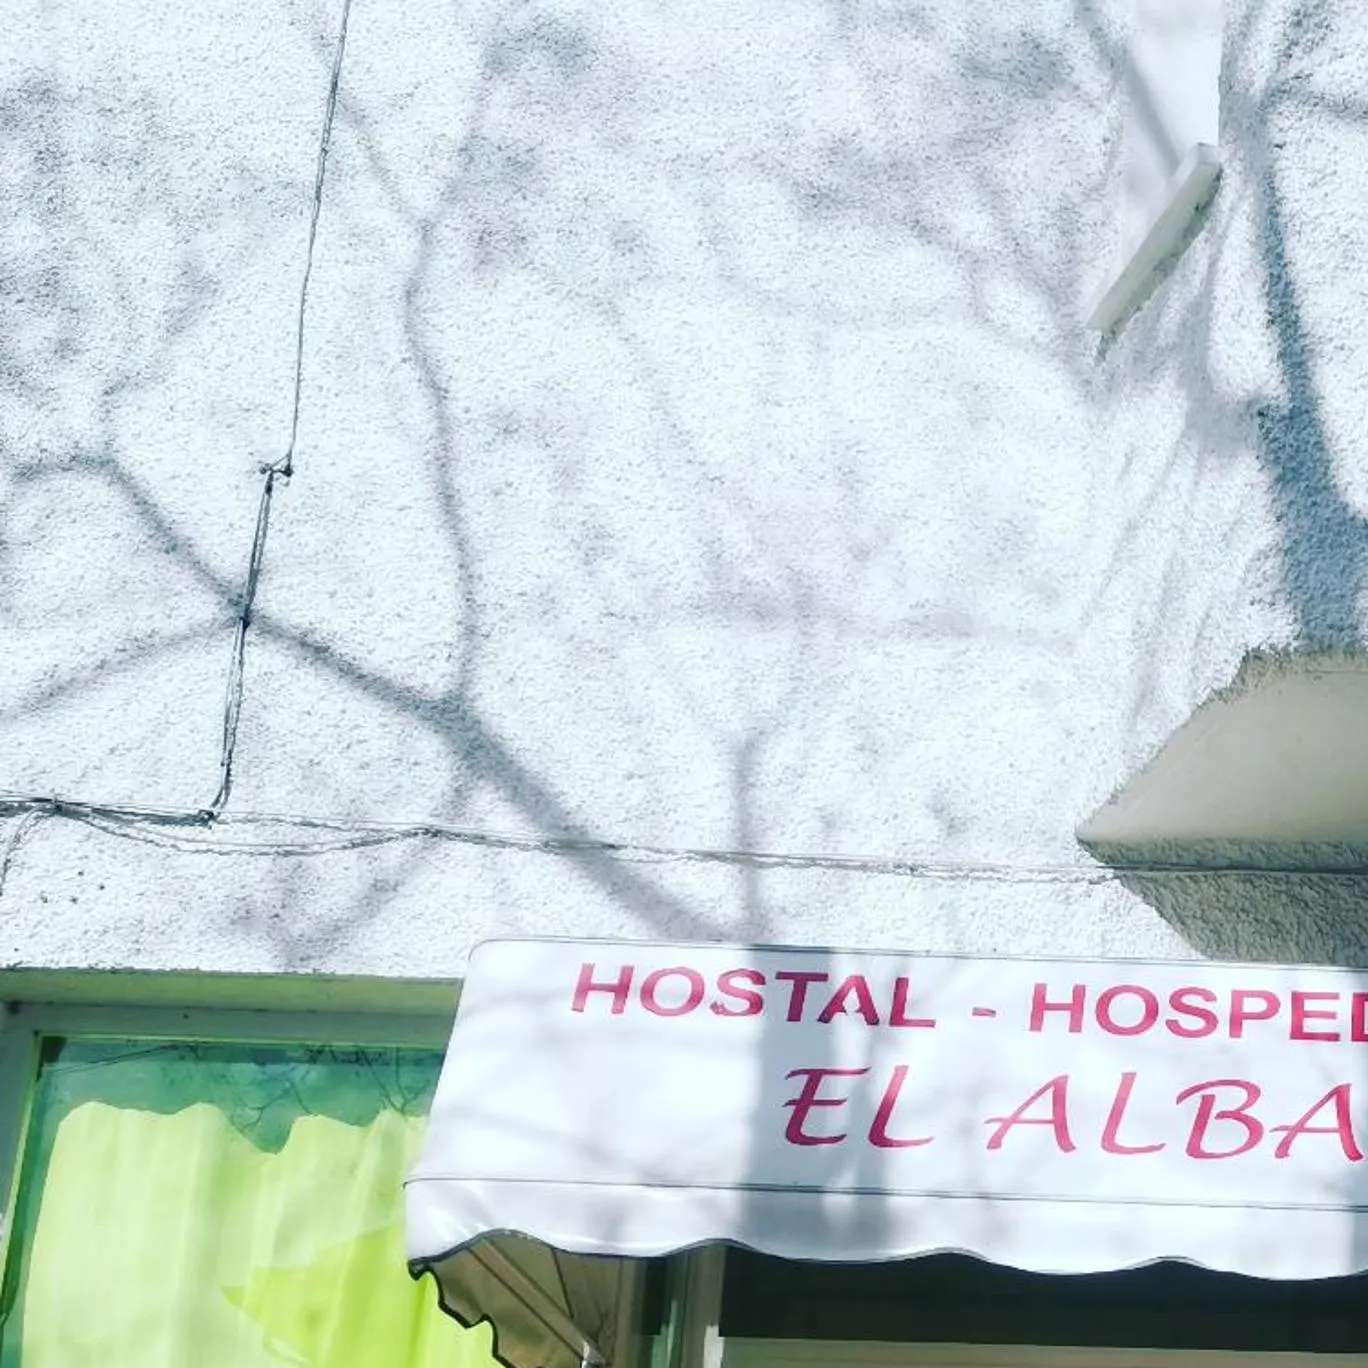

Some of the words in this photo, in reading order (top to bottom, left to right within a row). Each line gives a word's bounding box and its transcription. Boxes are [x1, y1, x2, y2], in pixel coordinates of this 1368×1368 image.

[571, 963, 936, 1028] HOSTAL
[783, 1064, 935, 1149] EL
[985, 1070, 1365, 1162] ALBA
